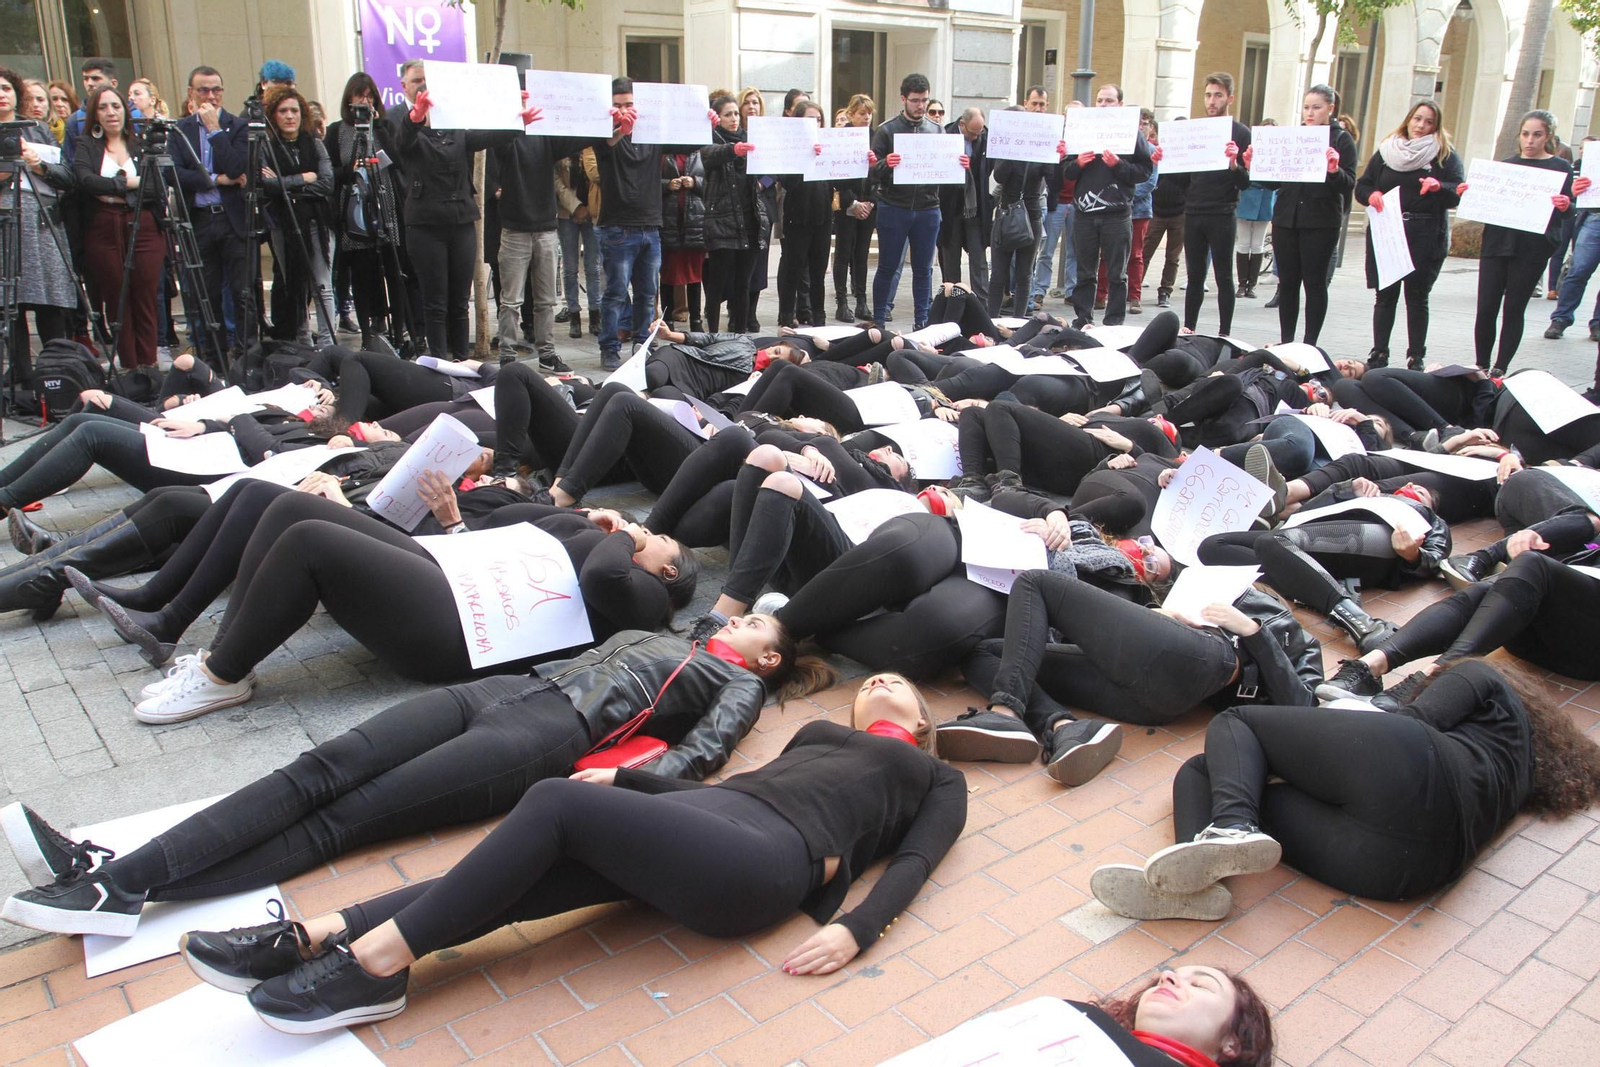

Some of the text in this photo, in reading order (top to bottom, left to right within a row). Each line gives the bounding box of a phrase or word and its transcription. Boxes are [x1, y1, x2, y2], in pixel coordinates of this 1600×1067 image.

[1256, 132, 1264, 144] A
[1268, 136, 1293, 144] NIVEL
[1185, 463, 1214, 490] 66
